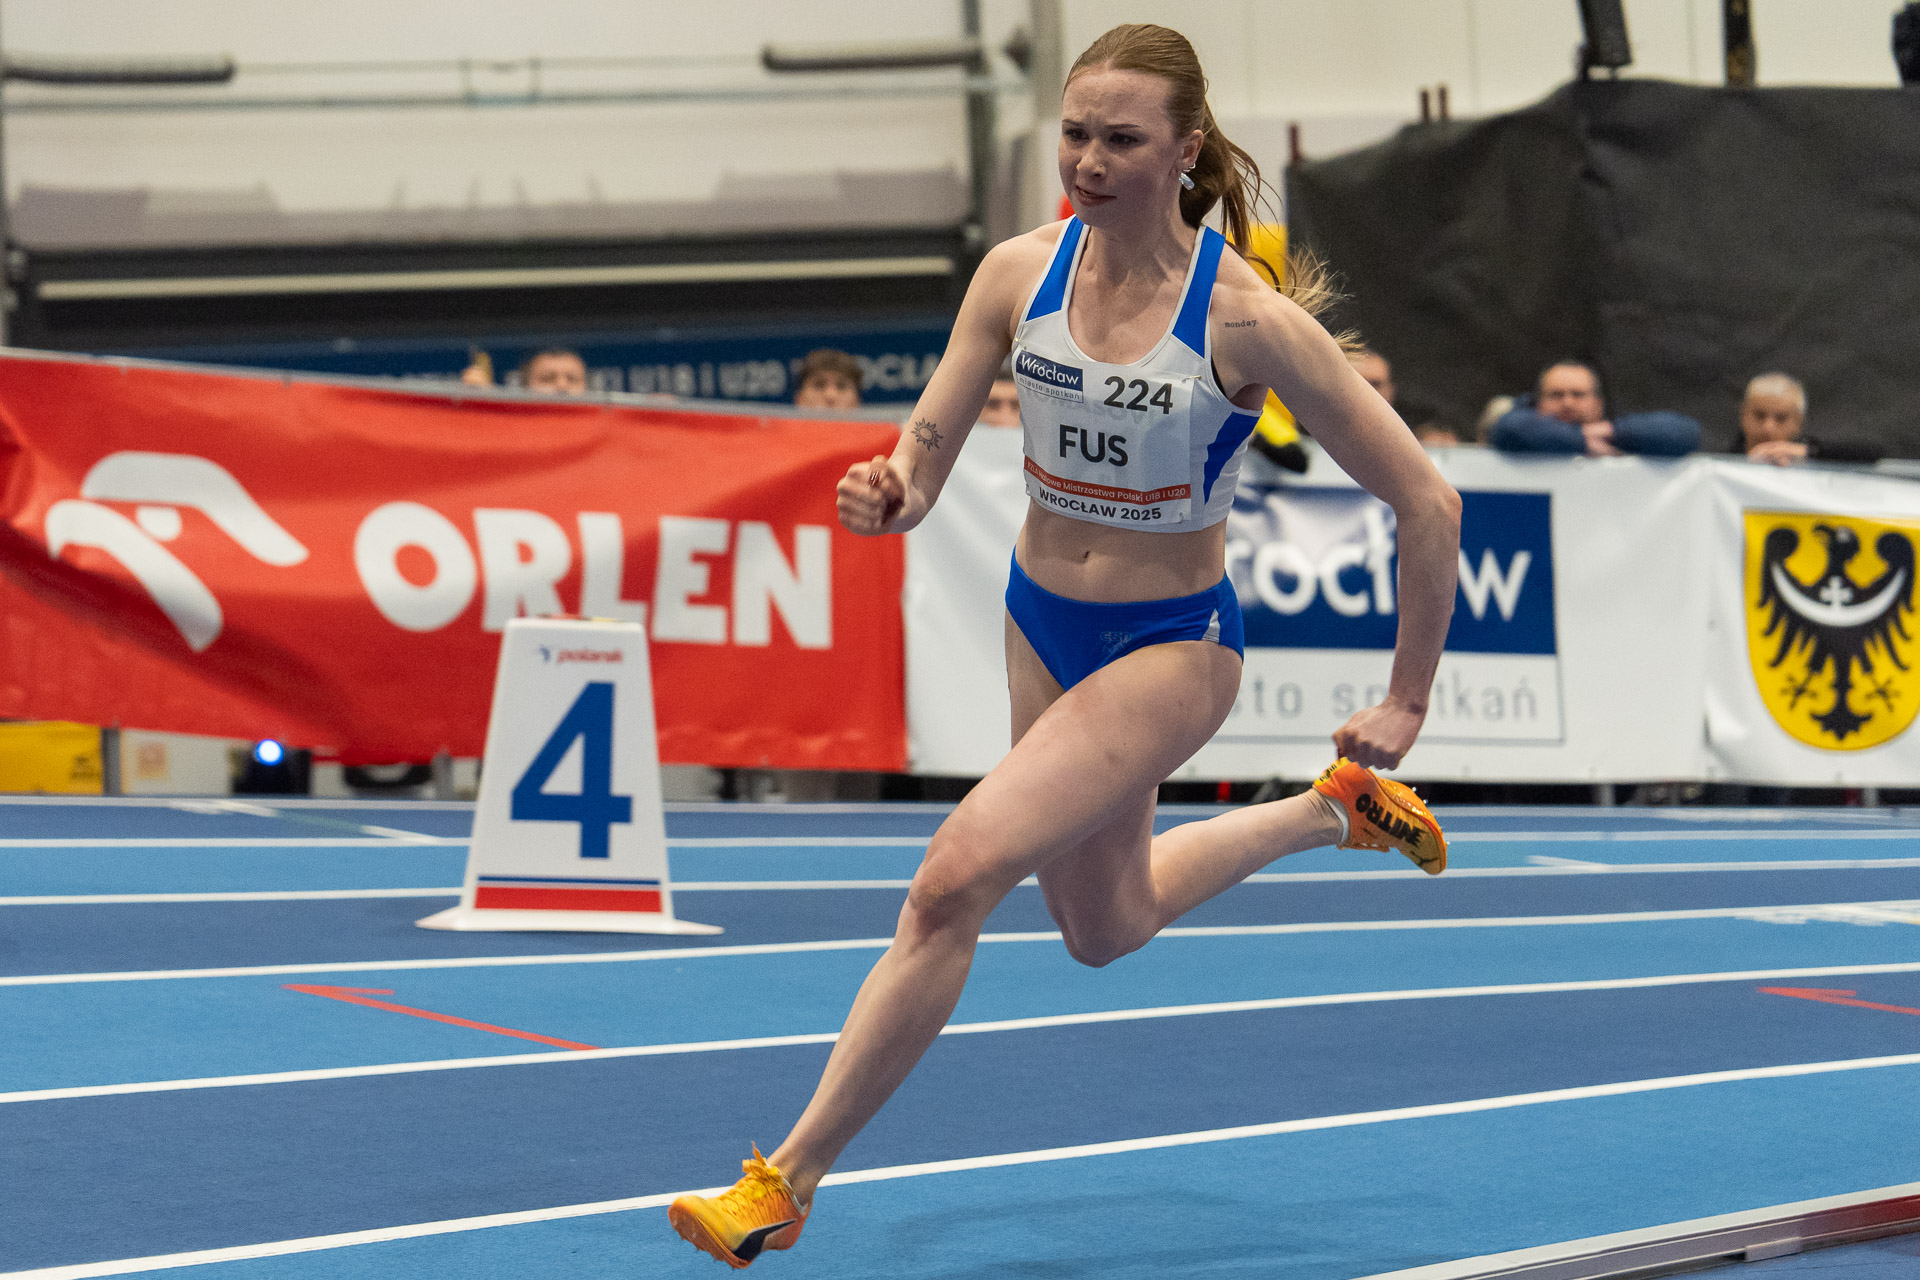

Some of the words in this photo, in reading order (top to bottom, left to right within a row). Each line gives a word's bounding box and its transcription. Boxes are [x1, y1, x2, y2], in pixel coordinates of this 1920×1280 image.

[1224, 320, 1257, 328] monday
[1021, 354, 1079, 390] Wrocław
[1103, 375, 1173, 415] 224
[1059, 423, 1129, 468] FUS
[1039, 486, 1117, 518] WROCŁAW
[1120, 507, 1162, 521] 2025
[1063, 482, 1115, 498] Mistrzostwa
[1117, 491, 1143, 502] Polski
[1145, 492, 1160, 502] U18
[1167, 488, 1186, 498] U20
[353, 500, 833, 649] ORLEN
[510, 680, 633, 859] 4
[1356, 793, 1426, 848] NITRO
